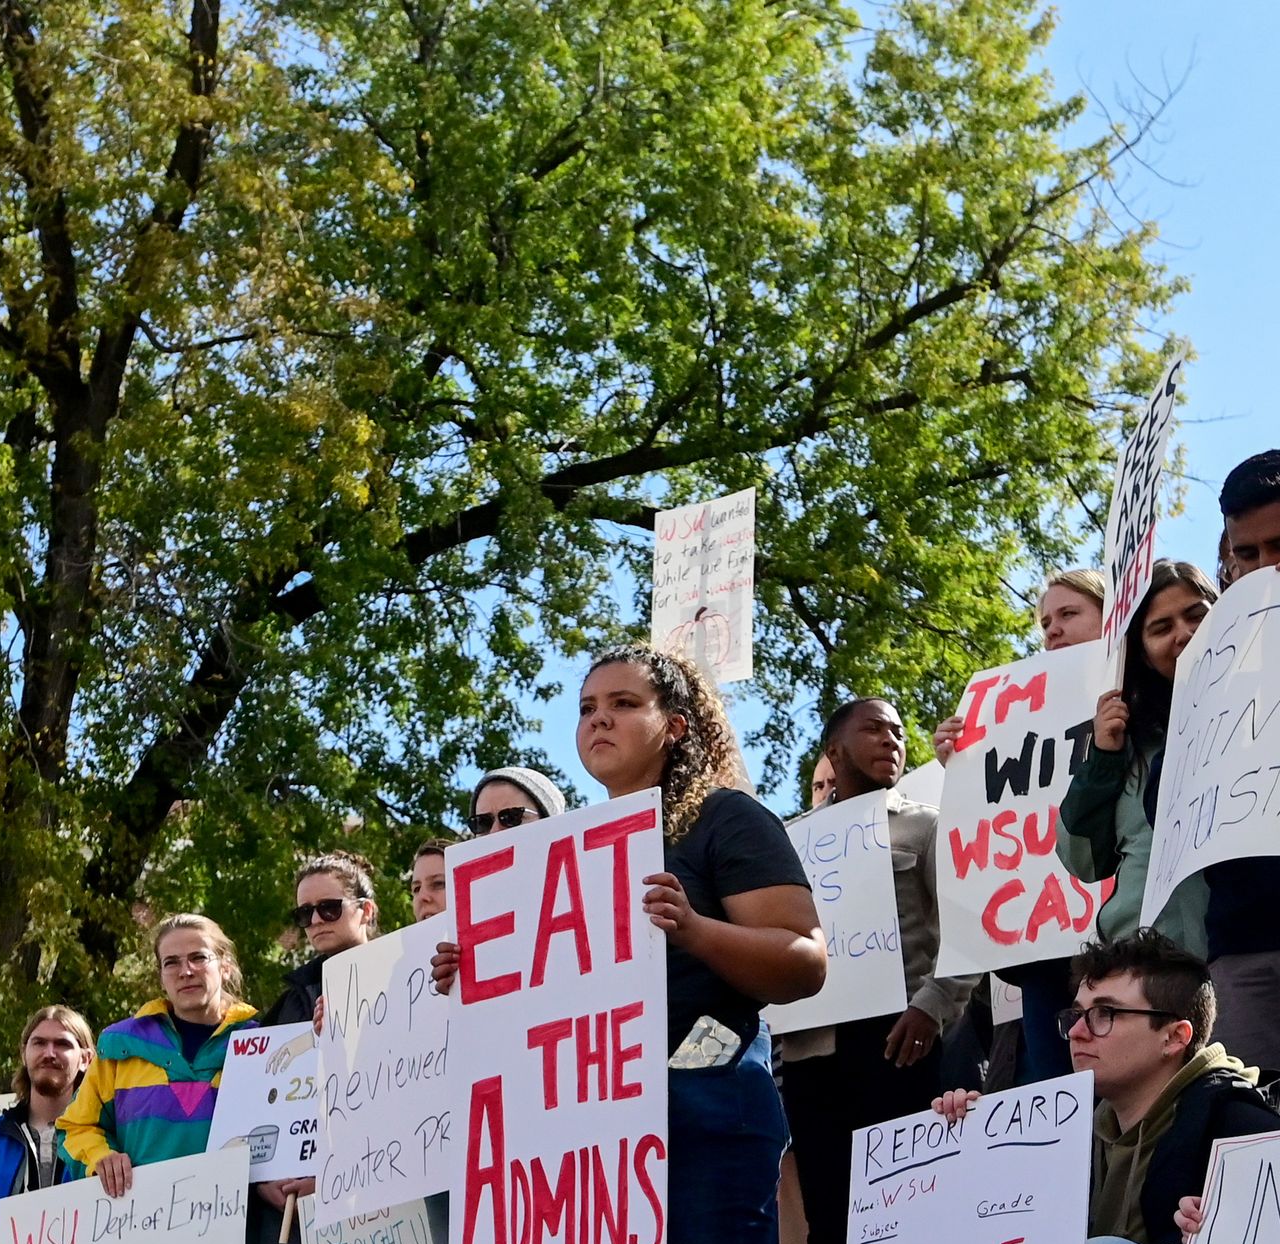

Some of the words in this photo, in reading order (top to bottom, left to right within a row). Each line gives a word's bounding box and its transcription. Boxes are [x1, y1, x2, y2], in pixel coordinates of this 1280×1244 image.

[653, 550, 673, 567] to
[681, 537, 716, 558] take
[657, 508, 706, 541] WSU
[654, 565, 691, 589] while
[701, 558, 722, 576] we
[954, 671, 1049, 753] I'M
[948, 803, 1060, 881] WSU
[453, 807, 656, 1005] EAT
[325, 962, 388, 1043] Who
[233, 1036, 270, 1056] WSU
[323, 1019, 450, 1131] Reviewed
[527, 1001, 644, 1111] THE
[865, 1107, 976, 1177] REPORT
[984, 1090, 1079, 1138] CARD
[92, 1198, 137, 1242] Dept.
[142, 1208, 163, 1231] of
[168, 1175, 246, 1237] English
[852, 1199, 880, 1215] Name:
[881, 1174, 937, 1208] WSU
[976, 1193, 1035, 1217] Grade
[861, 1220, 899, 1240] Subject
